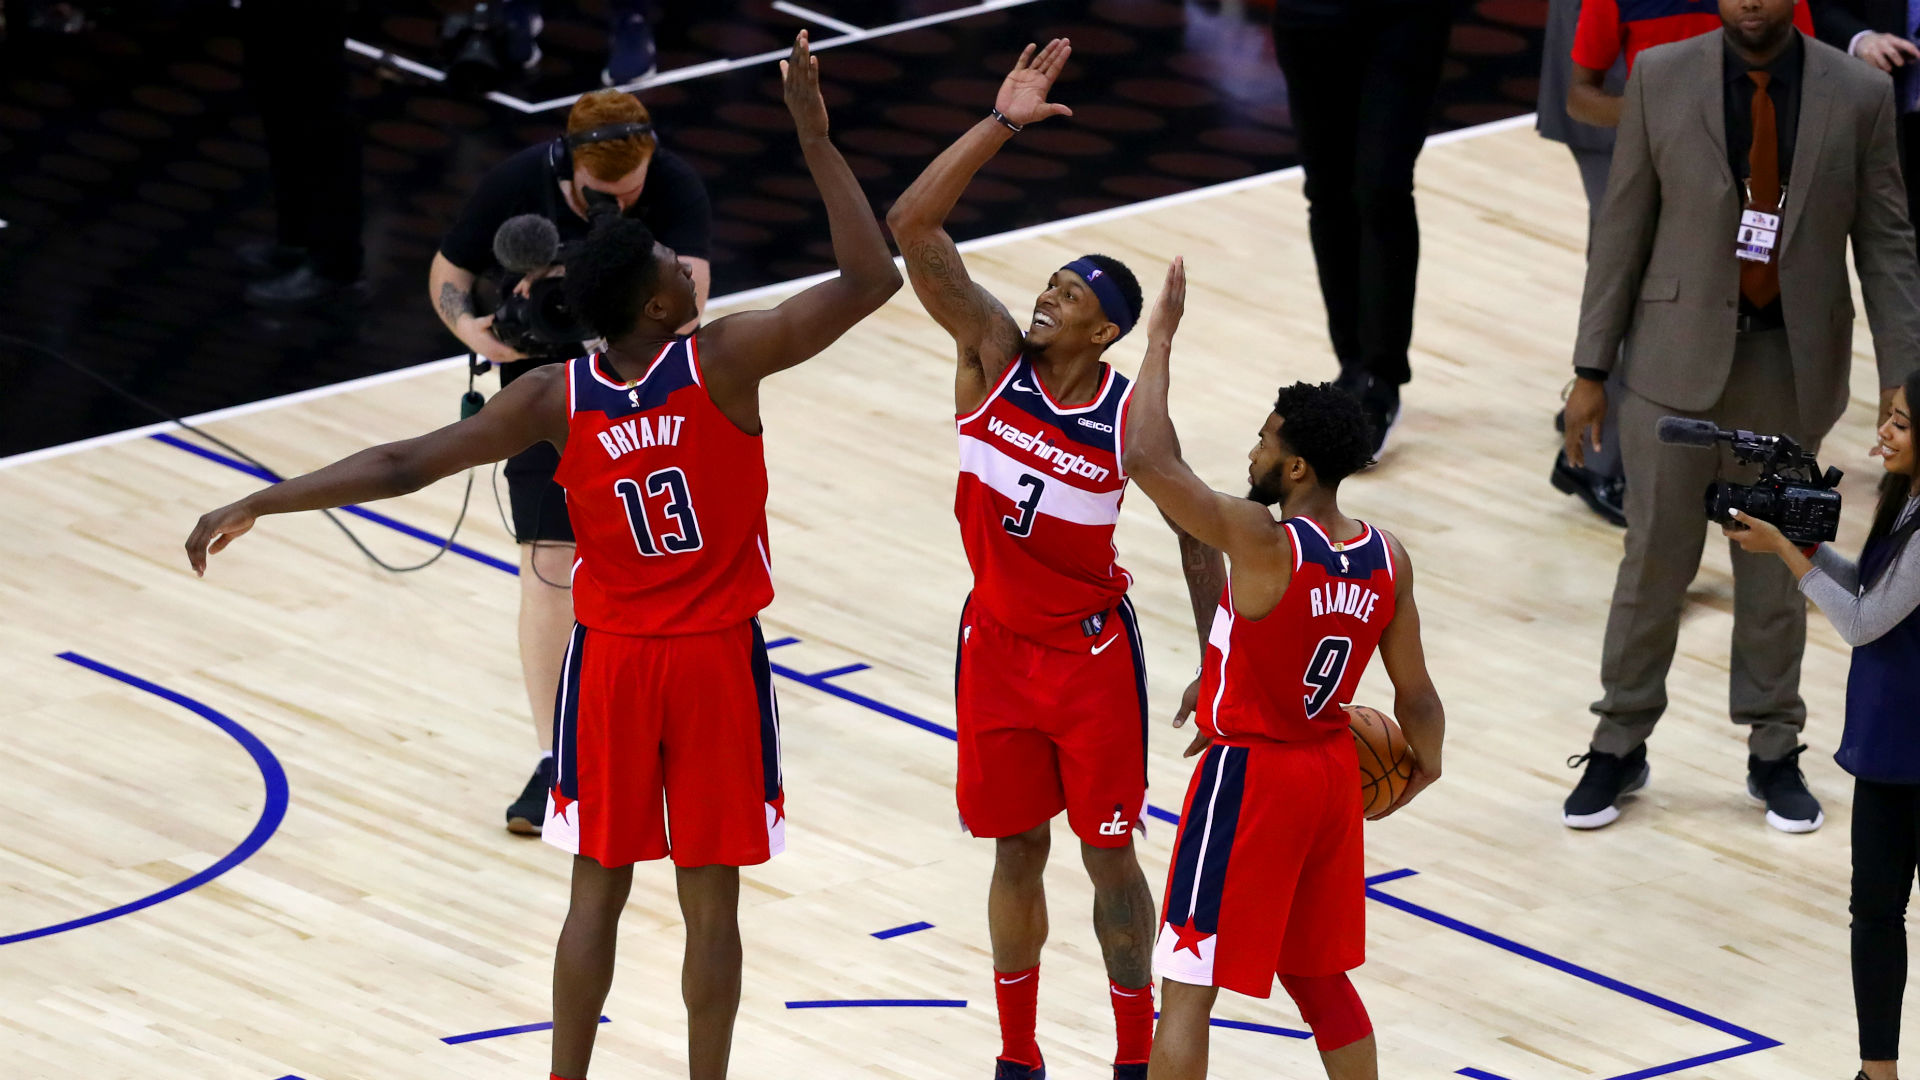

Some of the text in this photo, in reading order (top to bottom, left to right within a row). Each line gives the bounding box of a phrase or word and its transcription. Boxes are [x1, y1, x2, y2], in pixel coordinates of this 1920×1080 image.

[597, 415, 686, 460] BRYANT
[987, 416, 1110, 482] washington
[1077, 417, 1113, 433] GEICO
[614, 466, 704, 557] 13
[1002, 473, 1046, 538] 3
[1310, 582, 1380, 623] RANDLE
[1303, 636, 1353, 720] 9
